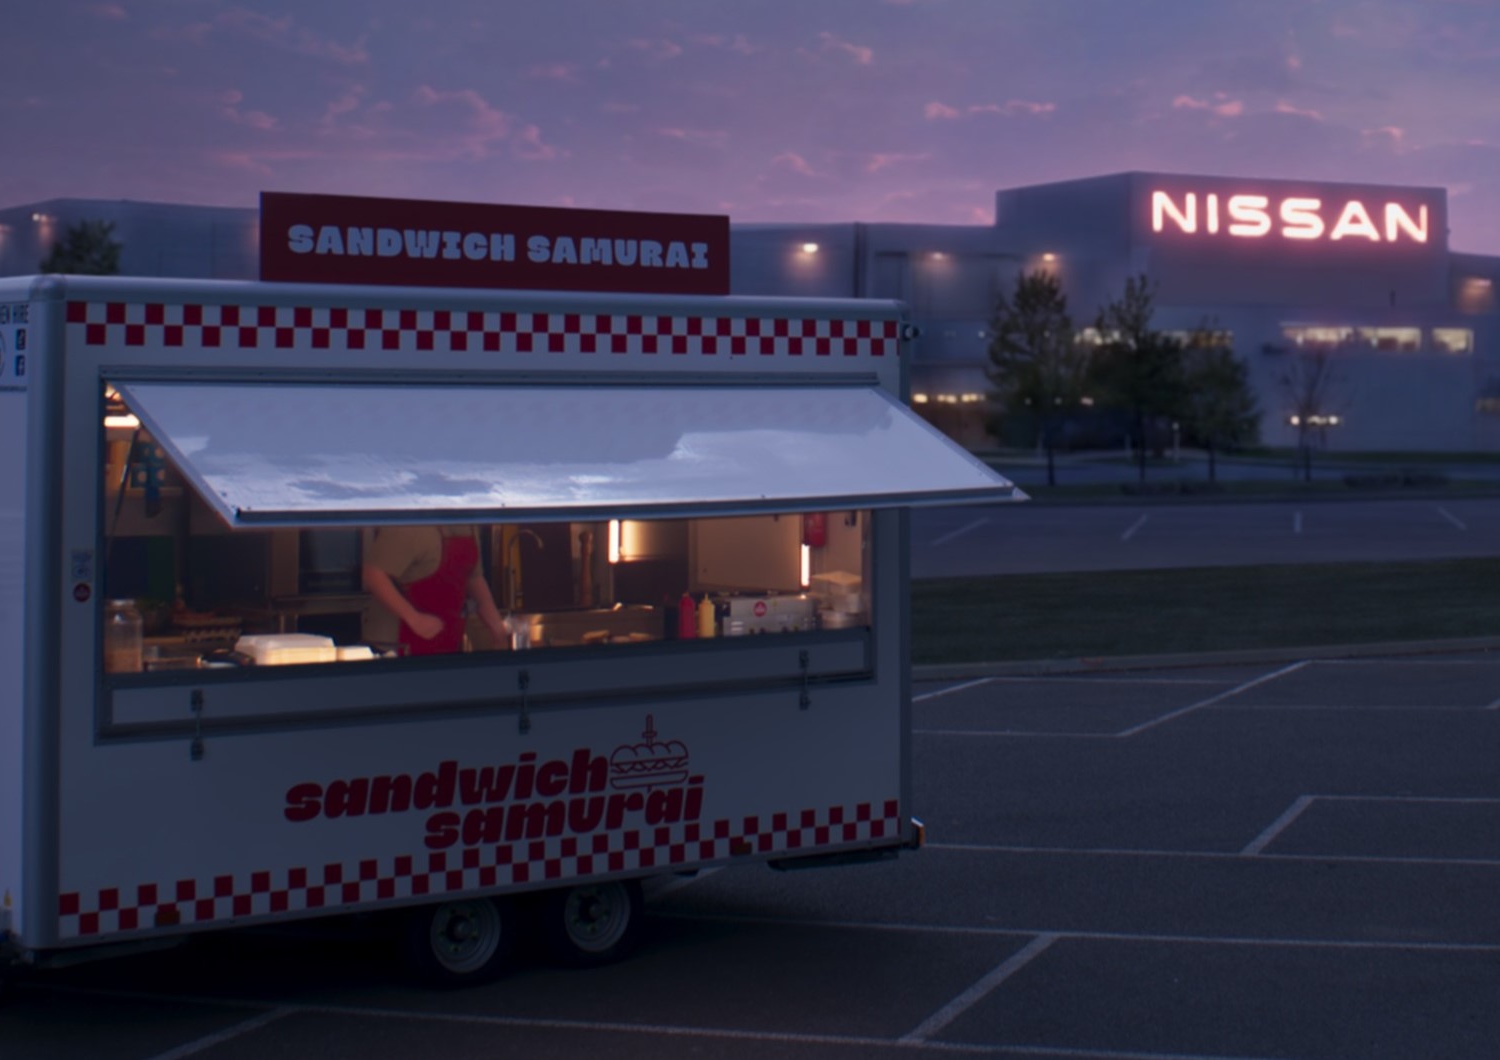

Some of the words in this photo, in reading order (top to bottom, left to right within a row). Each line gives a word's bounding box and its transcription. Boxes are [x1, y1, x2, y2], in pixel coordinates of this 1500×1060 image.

[287, 224, 515, 262] SANDWICH
[526, 235, 709, 269] SAMURAI
[1152, 190, 1428, 243] NISSAN
[284, 748, 608, 822] sandwich
[424, 776, 705, 849] samurai
